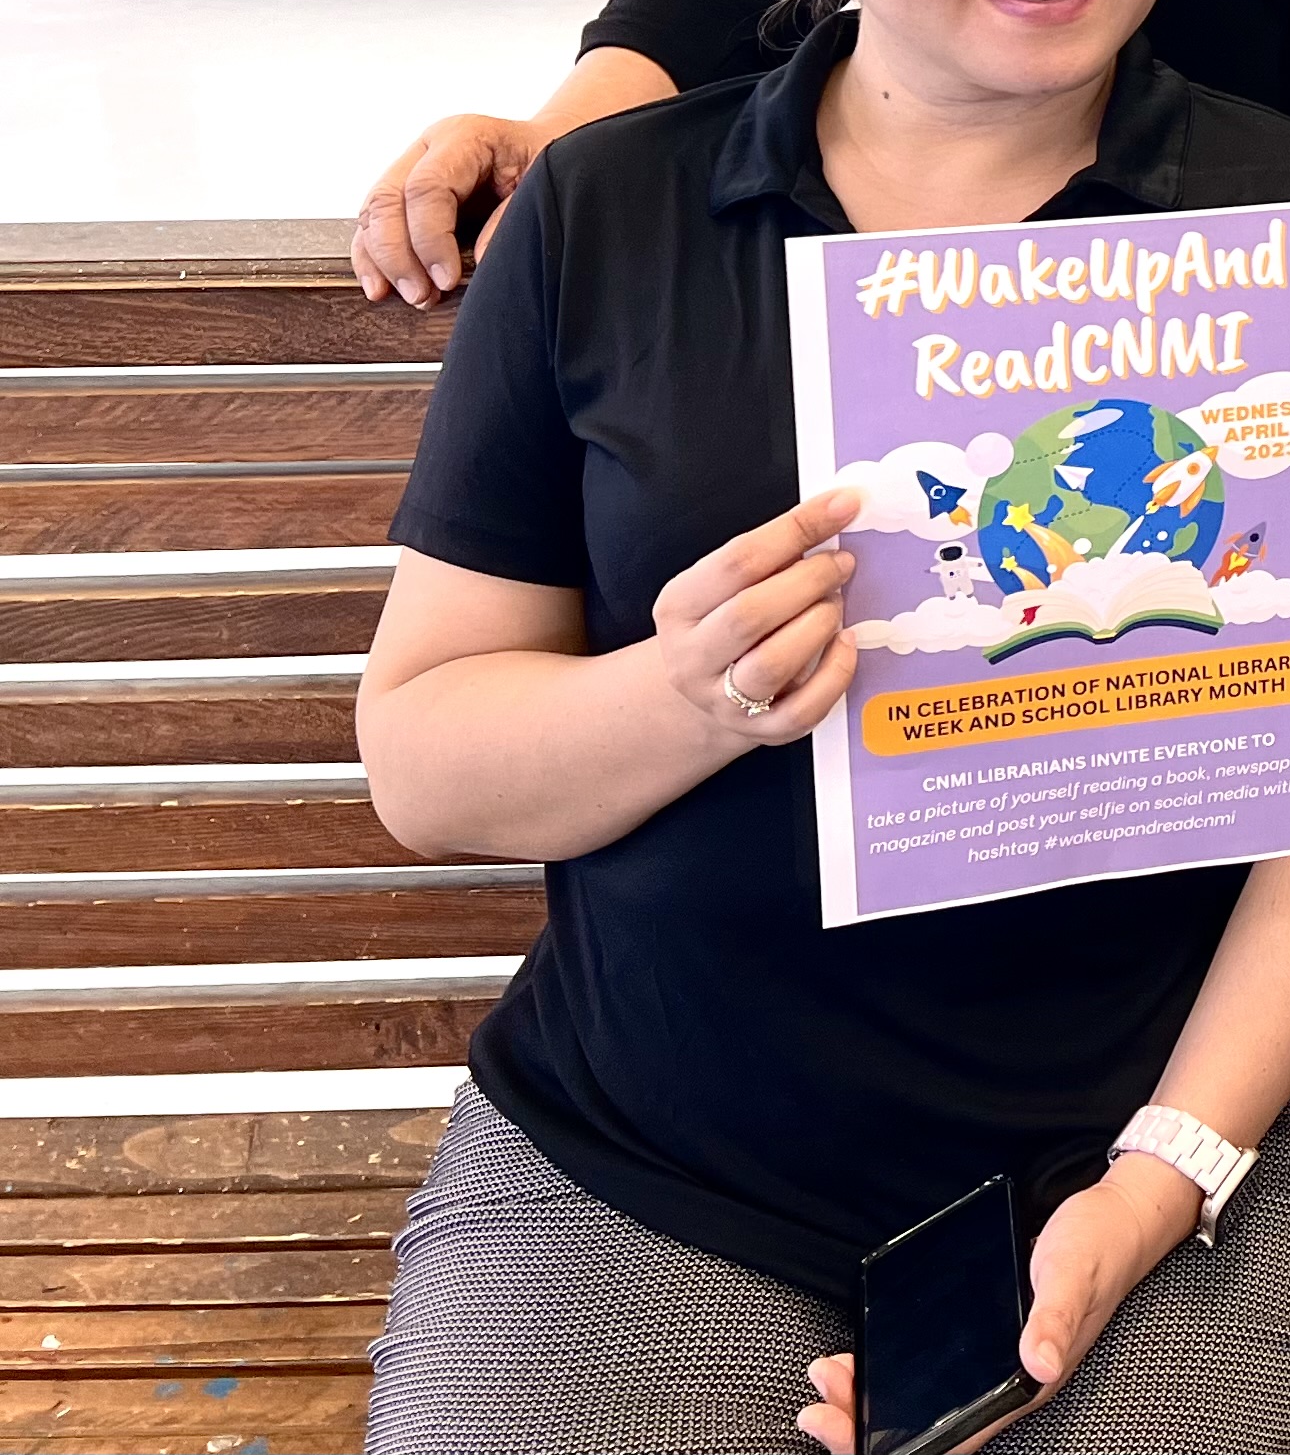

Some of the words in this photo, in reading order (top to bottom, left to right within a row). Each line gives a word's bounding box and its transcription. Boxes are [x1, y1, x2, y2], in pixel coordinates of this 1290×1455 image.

[856, 218, 1286, 318] #WakeUpAnd
[912, 310, 1252, 400] ReadCNMI
[1223, 422, 1289, 443] APRIL
[888, 704, 909, 721] IN
[917, 683, 1065, 717] CELEBRATION
[1072, 678, 1099, 695] OF
[1106, 665, 1212, 691] NATIONAL
[902, 718, 963, 740] WEEK
[968, 712, 1015, 731] AND
[1021, 698, 1110, 723] SCHOOL
[1116, 687, 1202, 711] LIBRARY
[1209, 677, 1284, 700] MONTH
[922, 771, 972, 791] CNMI
[977, 755, 1086, 783] LIBRARIANS
[1090, 748, 1149, 767] INVITE
[1154, 735, 1248, 760] EVERYONE
[1250, 732, 1275, 747] TO
[867, 810, 905, 828] take
[908, 809, 920, 821] a
[923, 798, 986, 822] picture
[989, 791, 1008, 811] of
[1010, 781, 1080, 809] yourself
[1082, 775, 1147, 794] reading
[1150, 774, 1162, 786] a
[1165, 765, 1210, 784] book,
[869, 829, 956, 854] magazine
[959, 819, 993, 838] and
[996, 814, 1035, 836] post
[1038, 810, 1077, 830] your
[1079, 801, 1125, 820] selfie
[1128, 800, 1150, 812] on
[1153, 790, 1202, 809] social
[1206, 784, 1259, 803] media
[967, 841, 1039, 862] hashtag
[1043, 810, 1236, 849] #wakeupandreadcnmi
